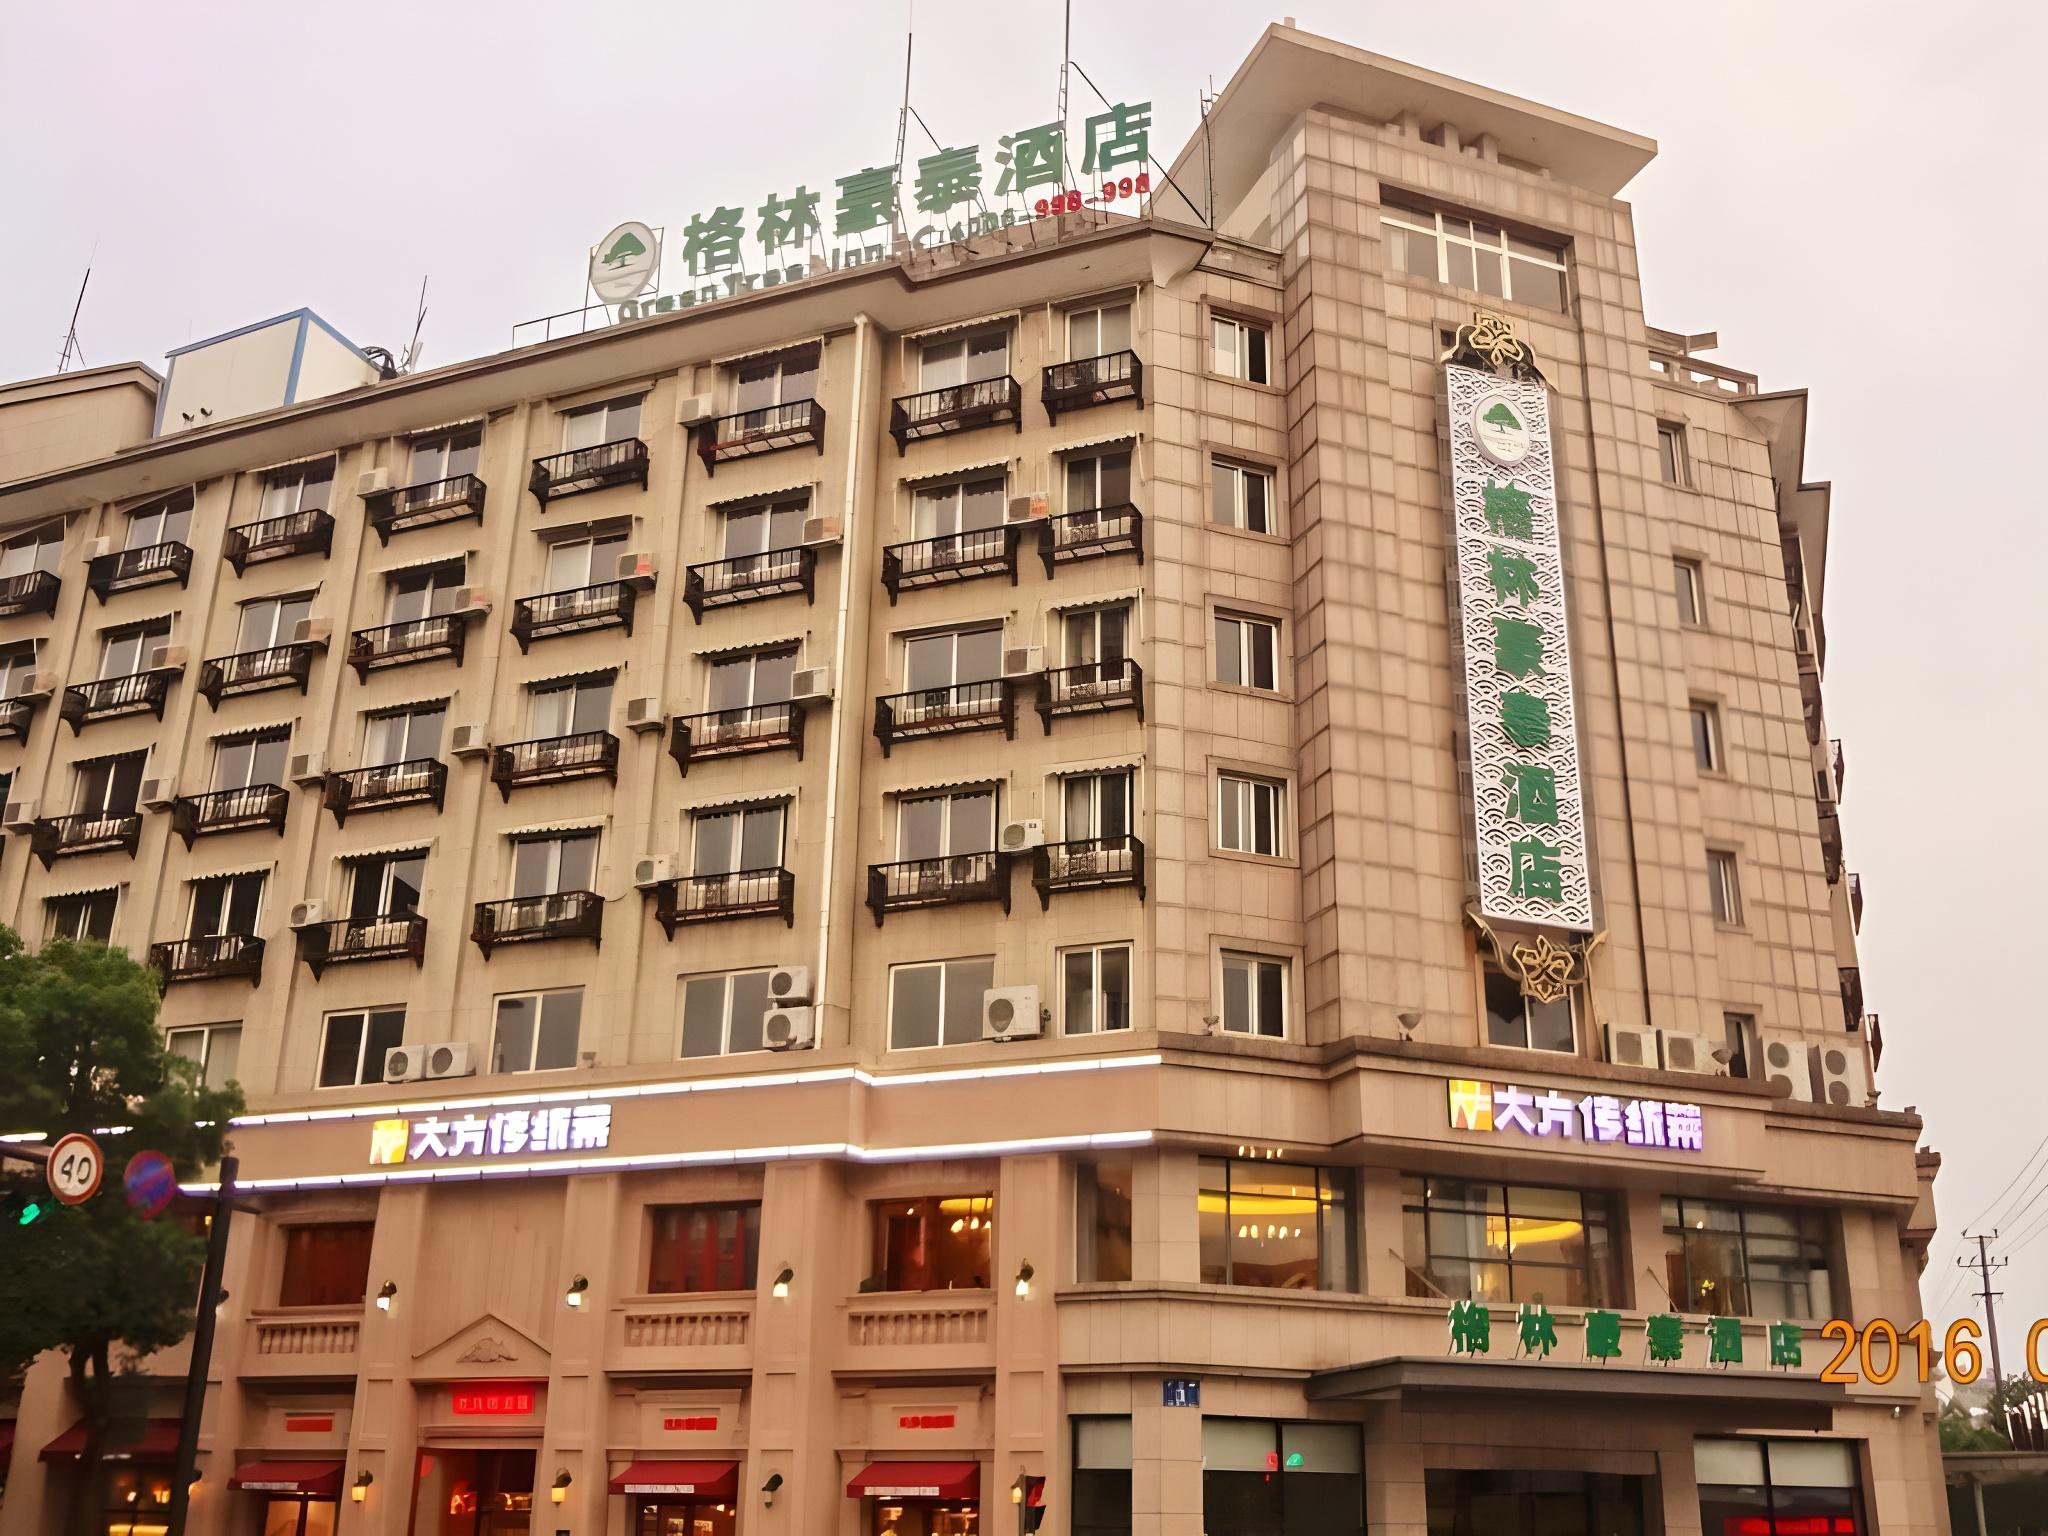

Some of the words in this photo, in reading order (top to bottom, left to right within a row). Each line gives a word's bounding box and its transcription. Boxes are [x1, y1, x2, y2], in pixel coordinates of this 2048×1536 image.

[61, 1154, 92, 1184] 40
[1447, 1299, 1802, 1368] 格林酒店
